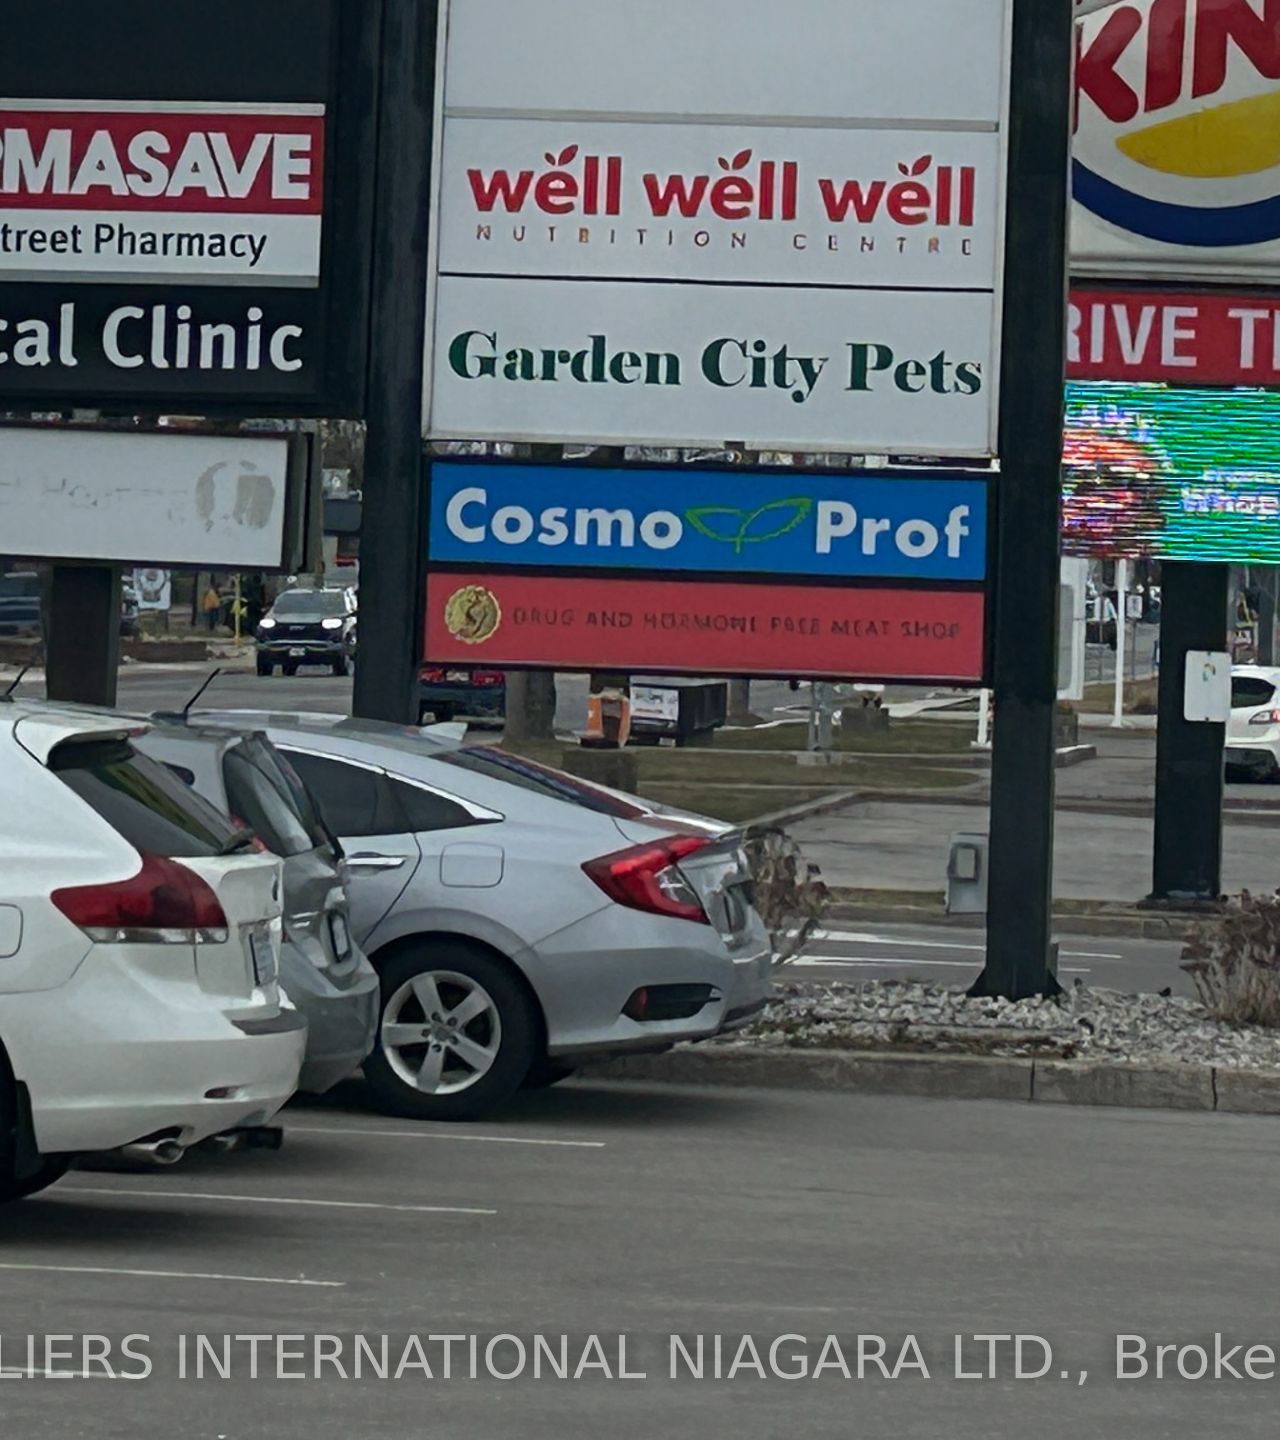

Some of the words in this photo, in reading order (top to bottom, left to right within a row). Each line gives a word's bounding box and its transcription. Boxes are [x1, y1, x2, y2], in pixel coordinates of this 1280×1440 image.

[95, 223, 266, 266] Pharmacy
[477, 225, 746, 248] NUTRITION
[793, 234, 970, 255] CENTRE
[103, 305, 302, 371] Clinic
[449, 331, 680, 385] Garden
[702, 339, 828, 403] City
[846, 343, 981, 394] Pets
[445, 487, 683, 549] Cosmo
[816, 501, 969, 557] Prof
[513, 607, 574, 626] DRUG
[587, 611, 632, 627] AND
[831, 620, 889, 636] MEAT
[901, 621, 958, 639] SHOP
